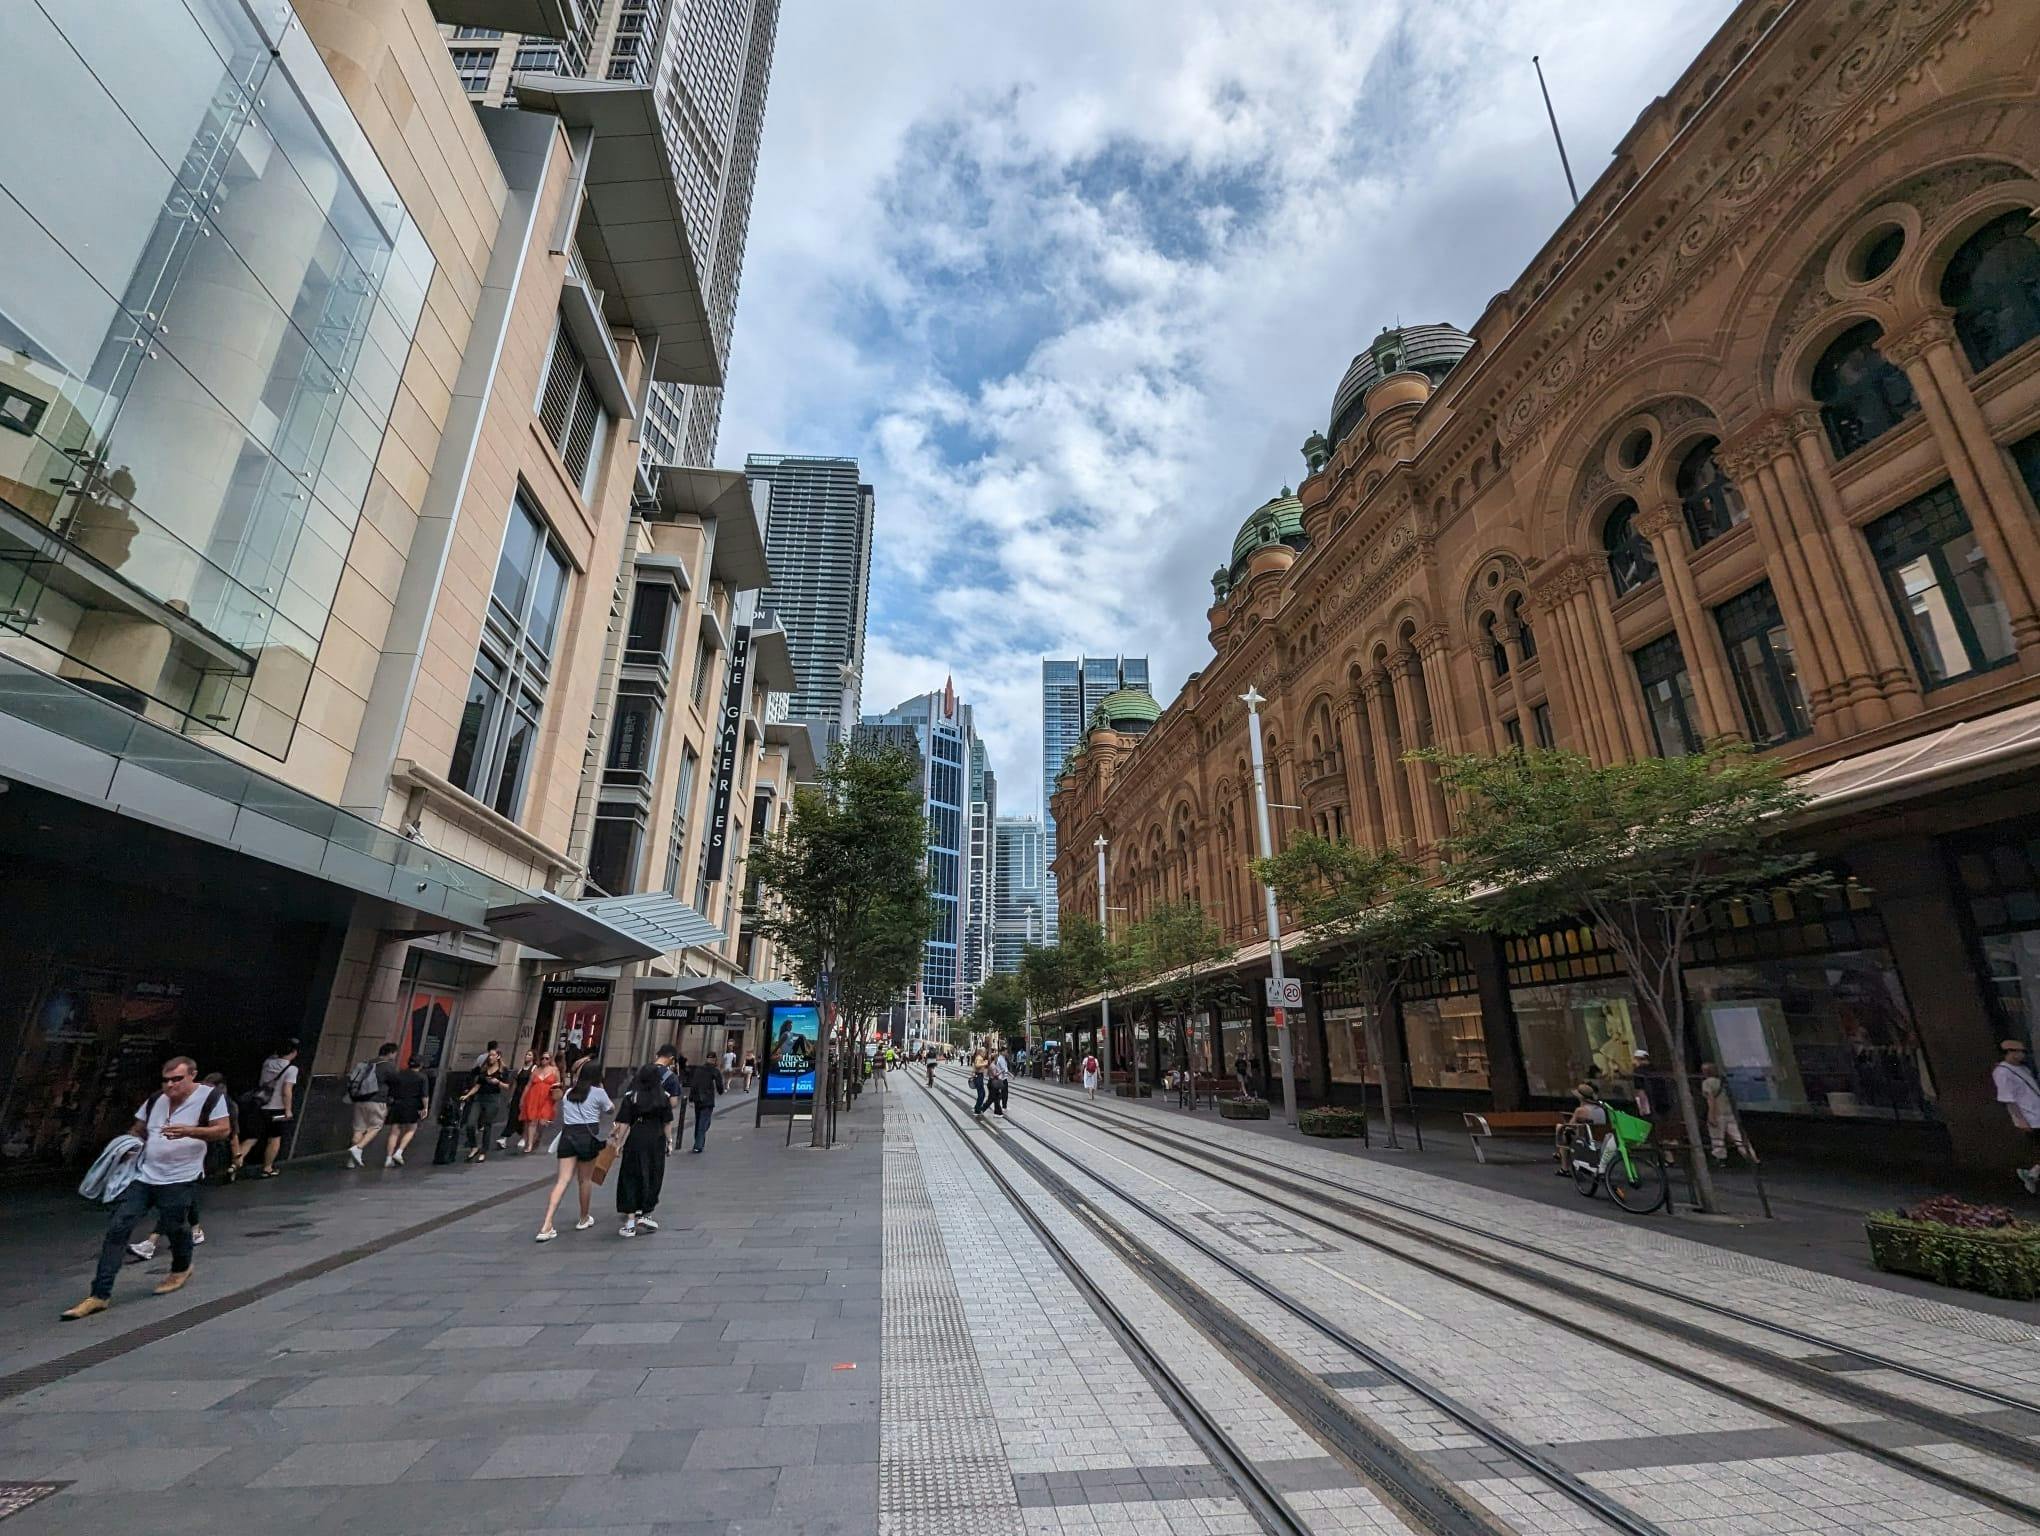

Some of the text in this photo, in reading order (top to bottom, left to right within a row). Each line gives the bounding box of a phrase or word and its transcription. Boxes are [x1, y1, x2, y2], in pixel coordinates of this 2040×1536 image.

[712, 640, 746, 847] THE GALERIES
[547, 986, 606, 994] THE GROUNDS
[1286, 988, 1299, 998] 20
[666, 1009, 688, 1017] NATION
[782, 1053, 804, 1062] three
